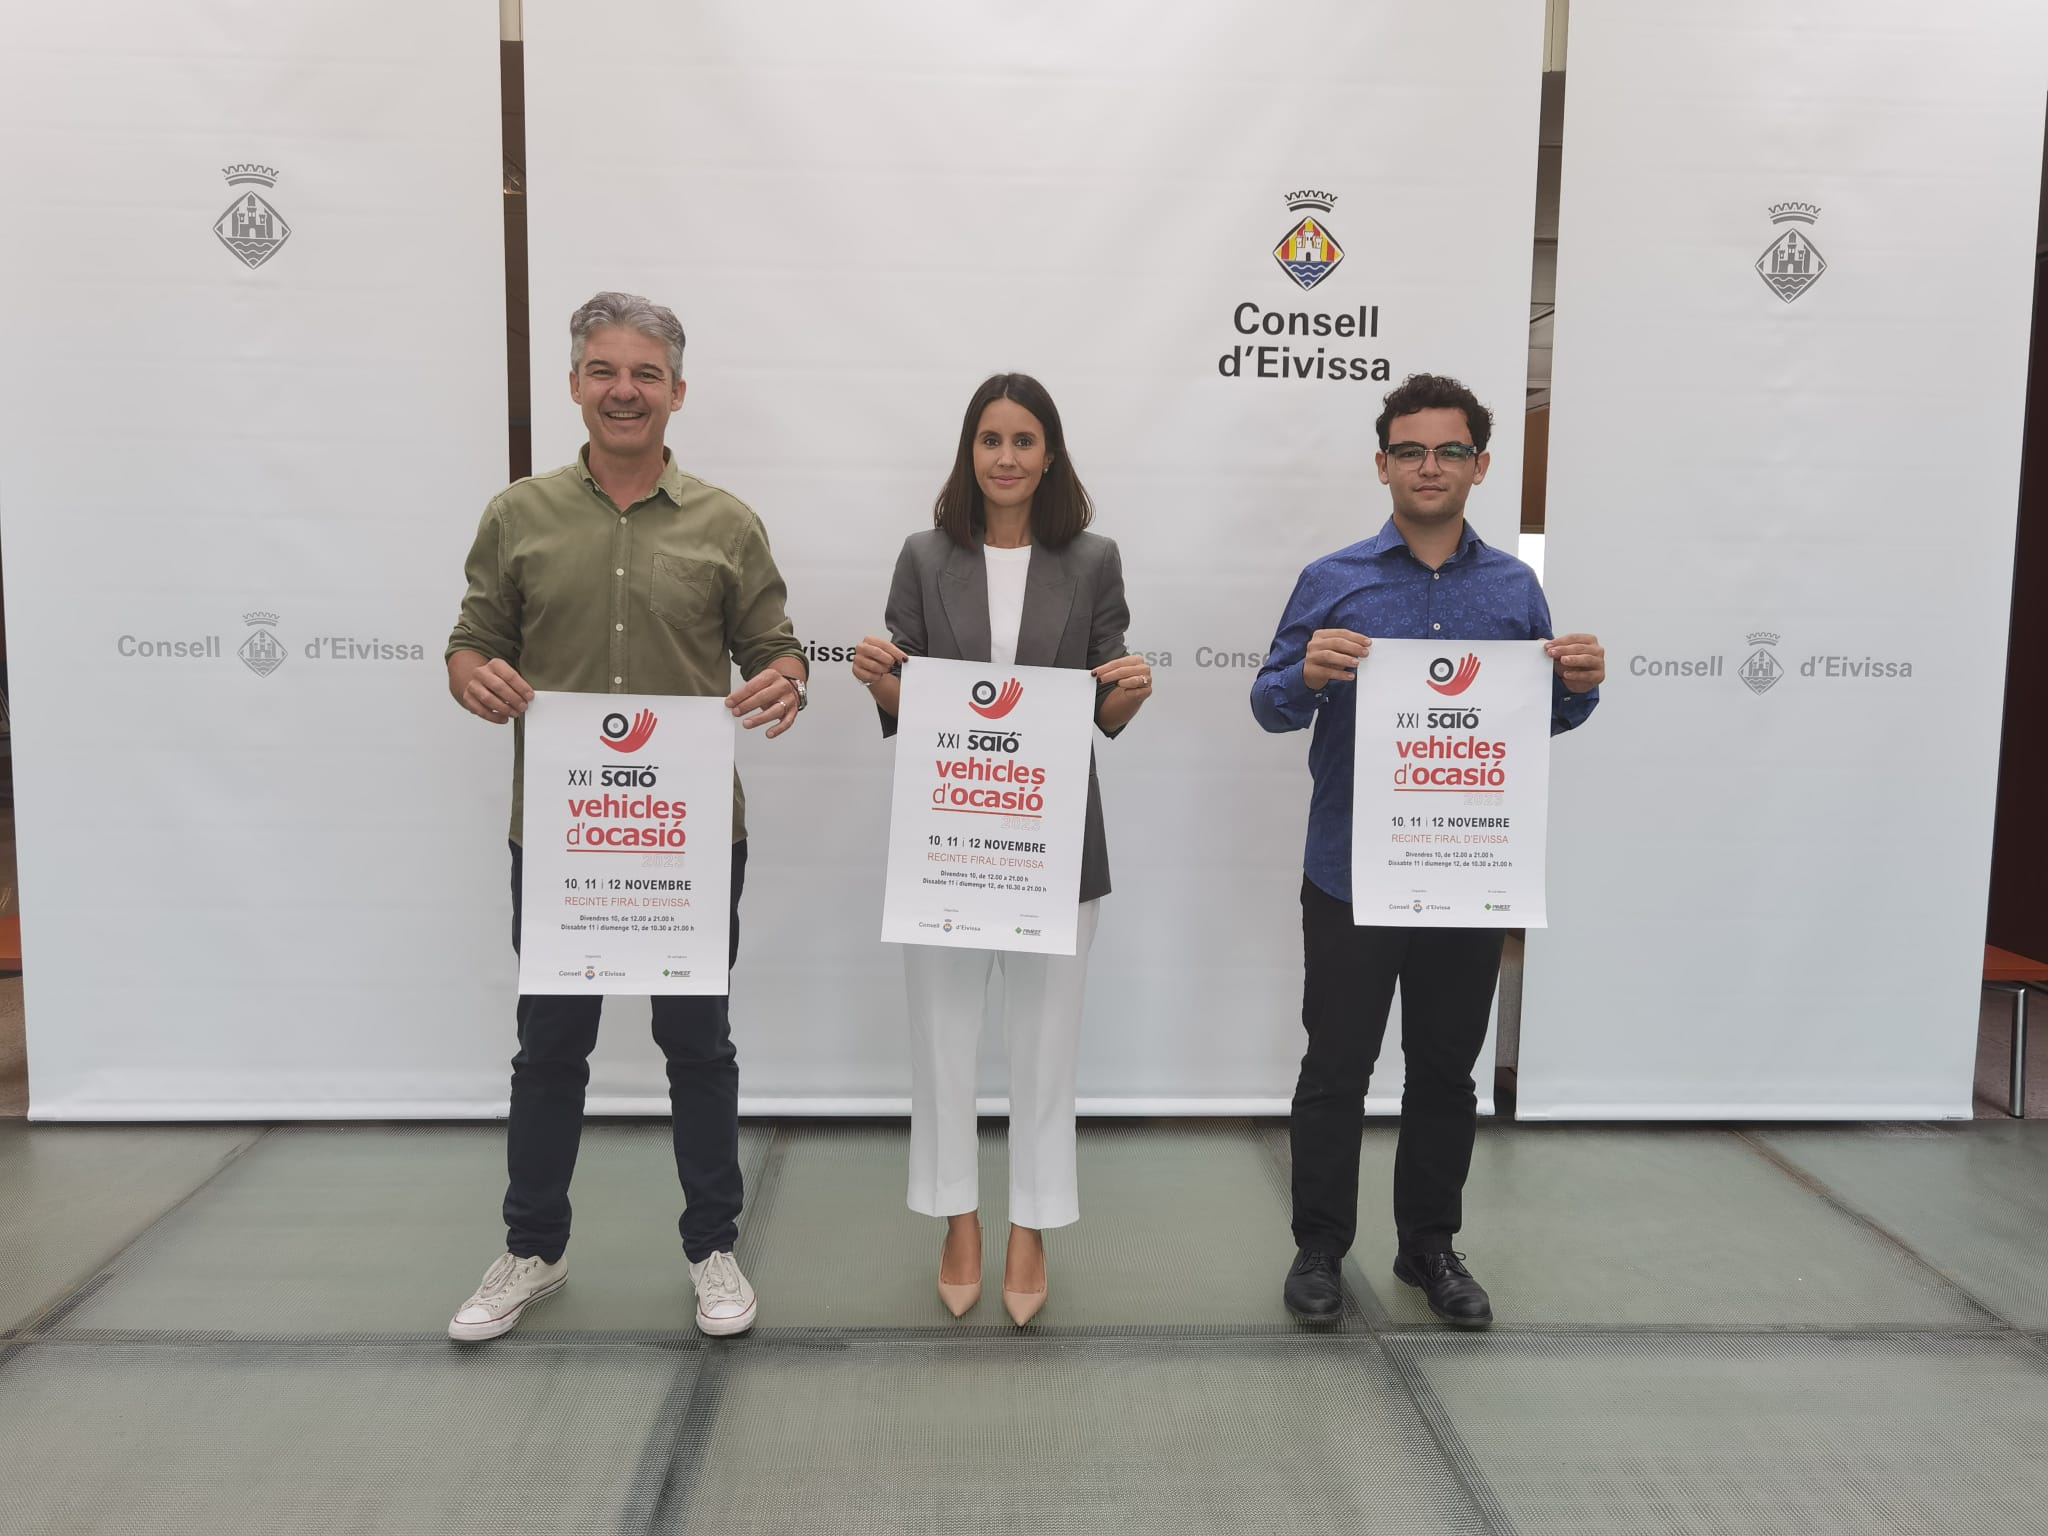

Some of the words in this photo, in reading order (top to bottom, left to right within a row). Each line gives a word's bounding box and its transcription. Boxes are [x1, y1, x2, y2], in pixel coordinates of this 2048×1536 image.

[1233, 302, 1379, 338] Consell
[1218, 345, 1390, 381] d'Eivissa
[117, 634, 221, 659] Consell
[304, 636, 425, 661] d'Eivissa
[1629, 655, 1724, 677] Consell
[1799, 656, 1913, 678] d'Eivissa
[1396, 712, 1419, 728] XXI
[1427, 707, 1479, 729] saló
[937, 732, 959, 749] XXI
[967, 732, 1020, 753] saló
[1396, 735, 1506, 759] vehicles
[567, 769, 592, 786] XXI
[600, 765, 656, 788] saló
[936, 757, 1045, 785] vehicles
[1394, 761, 1505, 786] d'ocasió
[567, 793, 687, 819] vehicles
[932, 782, 1043, 811] d'ocasió
[1410, 817, 1421, 826] 11
[1432, 817, 1444, 827] 12
[1448, 817, 1510, 828] NOVEMBRE
[566, 821, 686, 847] d'ocasió
[929, 835, 943, 847] 10,
[947, 836, 958, 847] 11
[968, 838, 980, 848] 12
[984, 839, 1046, 853] NOVEMBRE
[1391, 834, 1431, 842] RECINTE
[1434, 834, 1461, 843] FIRAL
[1464, 835, 1509, 844] D'EIVISSA
[928, 852, 968, 864] RECINTE
[970, 855, 997, 865] FIRAL
[999, 857, 1044, 869] D'EIVISSA
[1425, 860, 1451, 868] diumenge
[564, 878, 580, 891] 10,
[585, 879, 596, 889] 11
[608, 879, 620, 890] 12
[625, 880, 691, 890] NOVEMBRE
[940, 870, 968, 878] Divendres
[959, 880, 986, 889] diumenge
[565, 897, 608, 906] RECINTE
[611, 897, 639, 906] FIRAL
[643, 898, 690, 907] D'EIVISSA
